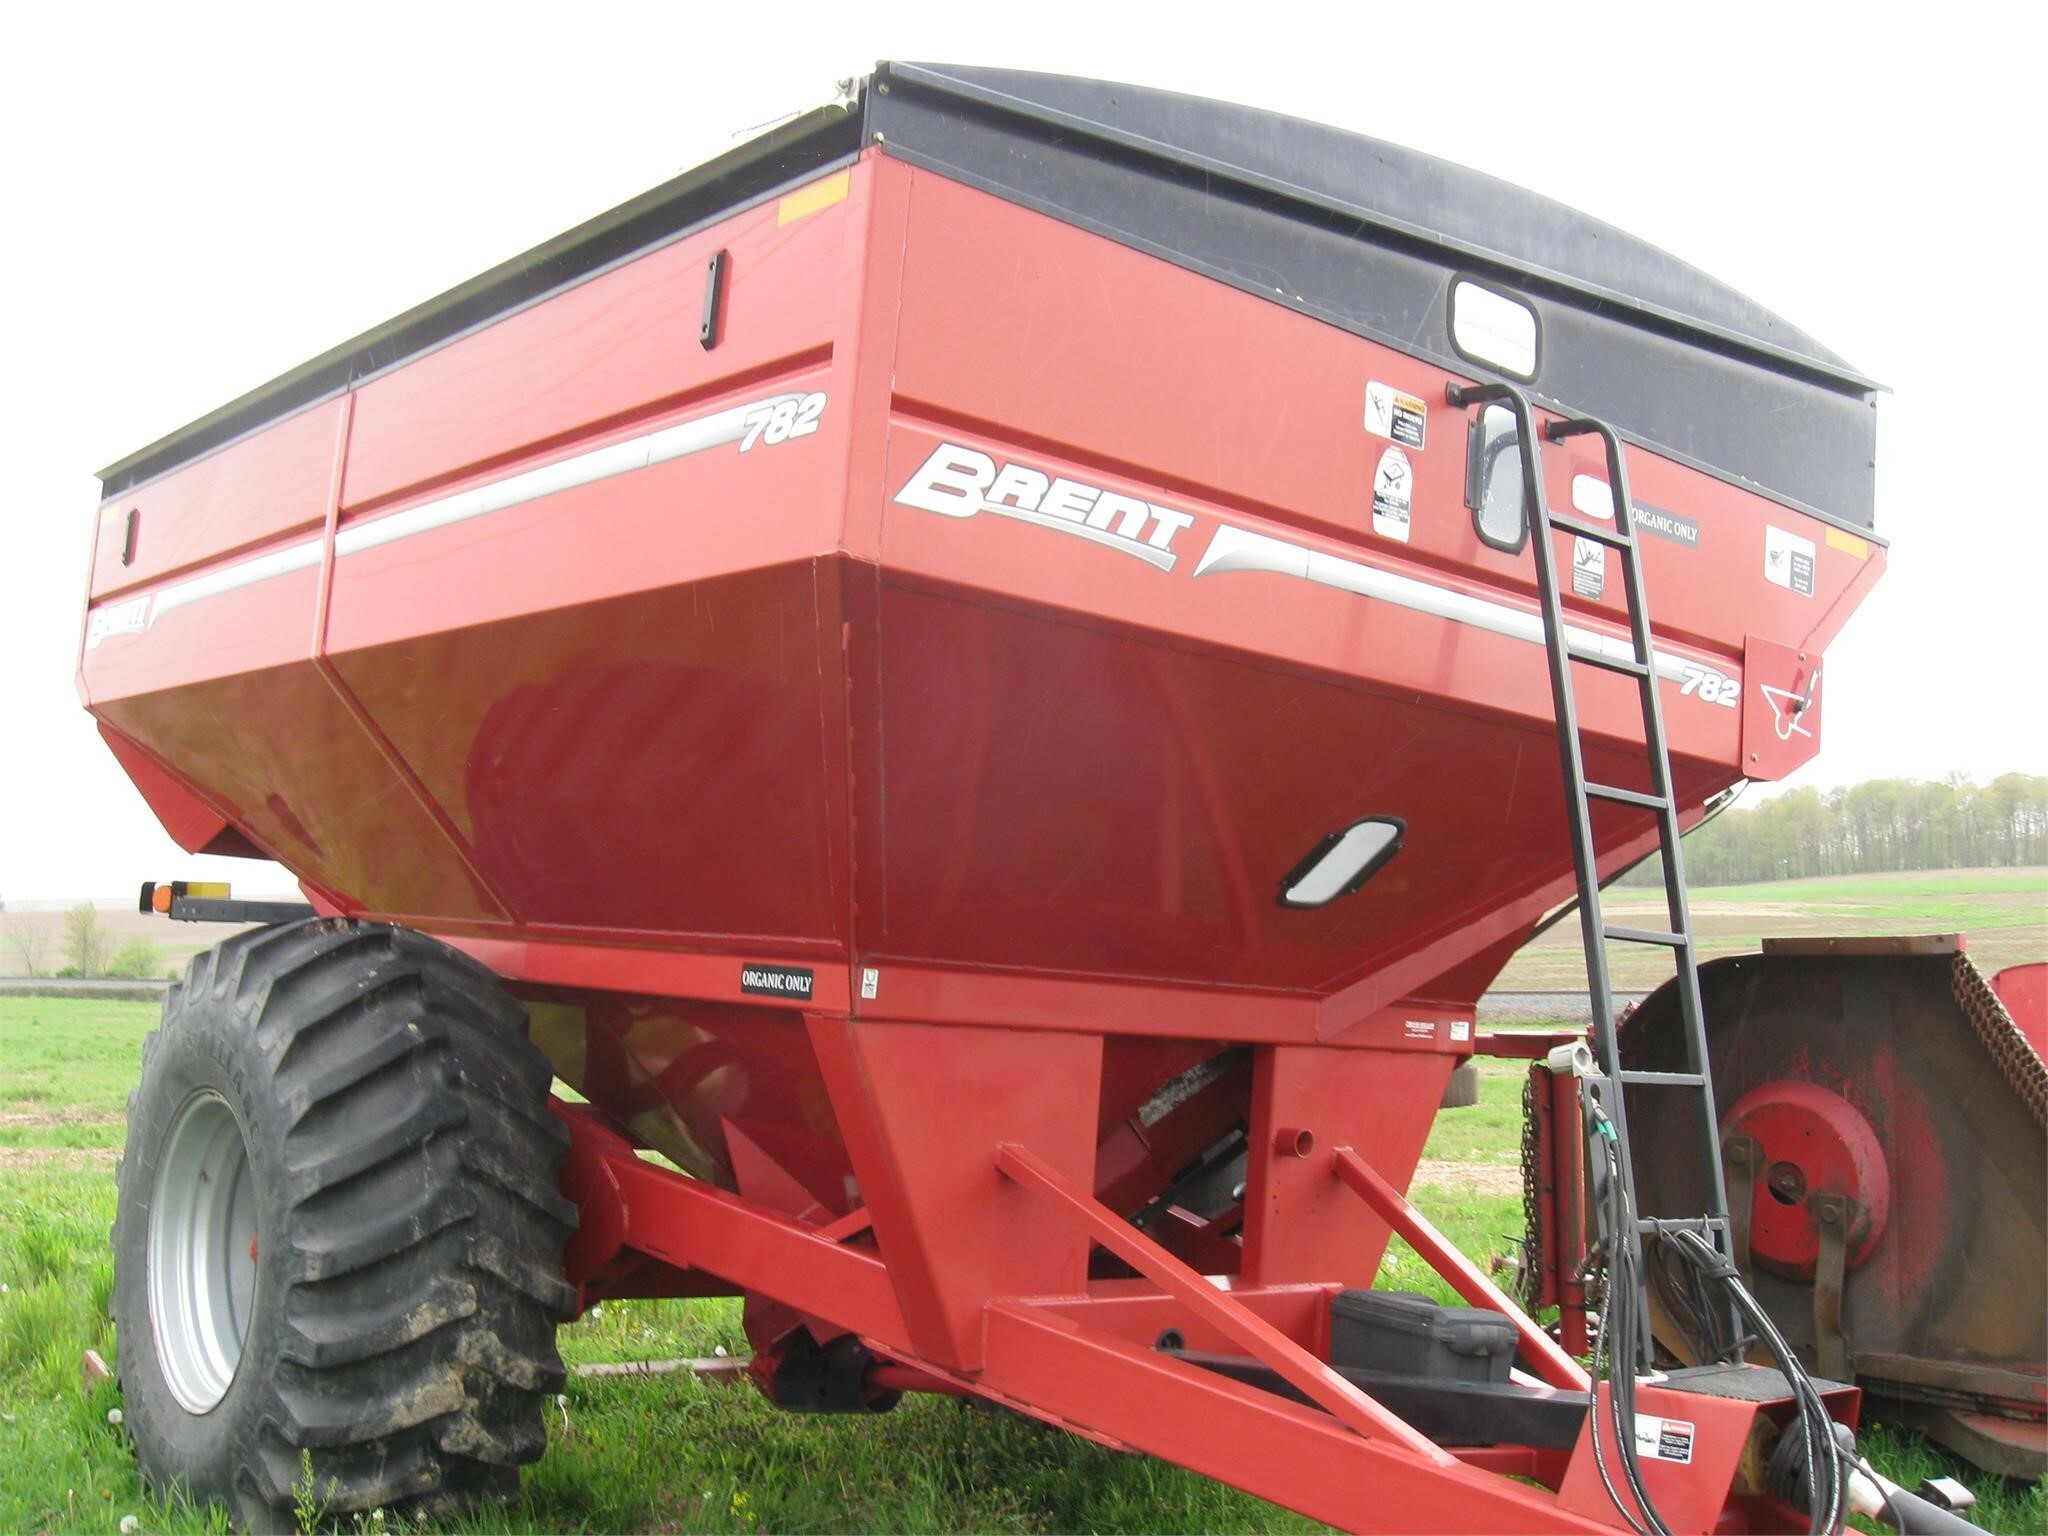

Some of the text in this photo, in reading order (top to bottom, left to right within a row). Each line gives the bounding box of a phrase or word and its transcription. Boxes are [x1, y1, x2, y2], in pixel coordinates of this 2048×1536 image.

[738, 391, 828, 453] 782
[893, 442, 1194, 552] BRENT
[1632, 507, 1698, 542] ORGANIC ONLY
[1679, 666, 1742, 709] 782
[742, 970, 812, 993] ORGANIC ONLY
